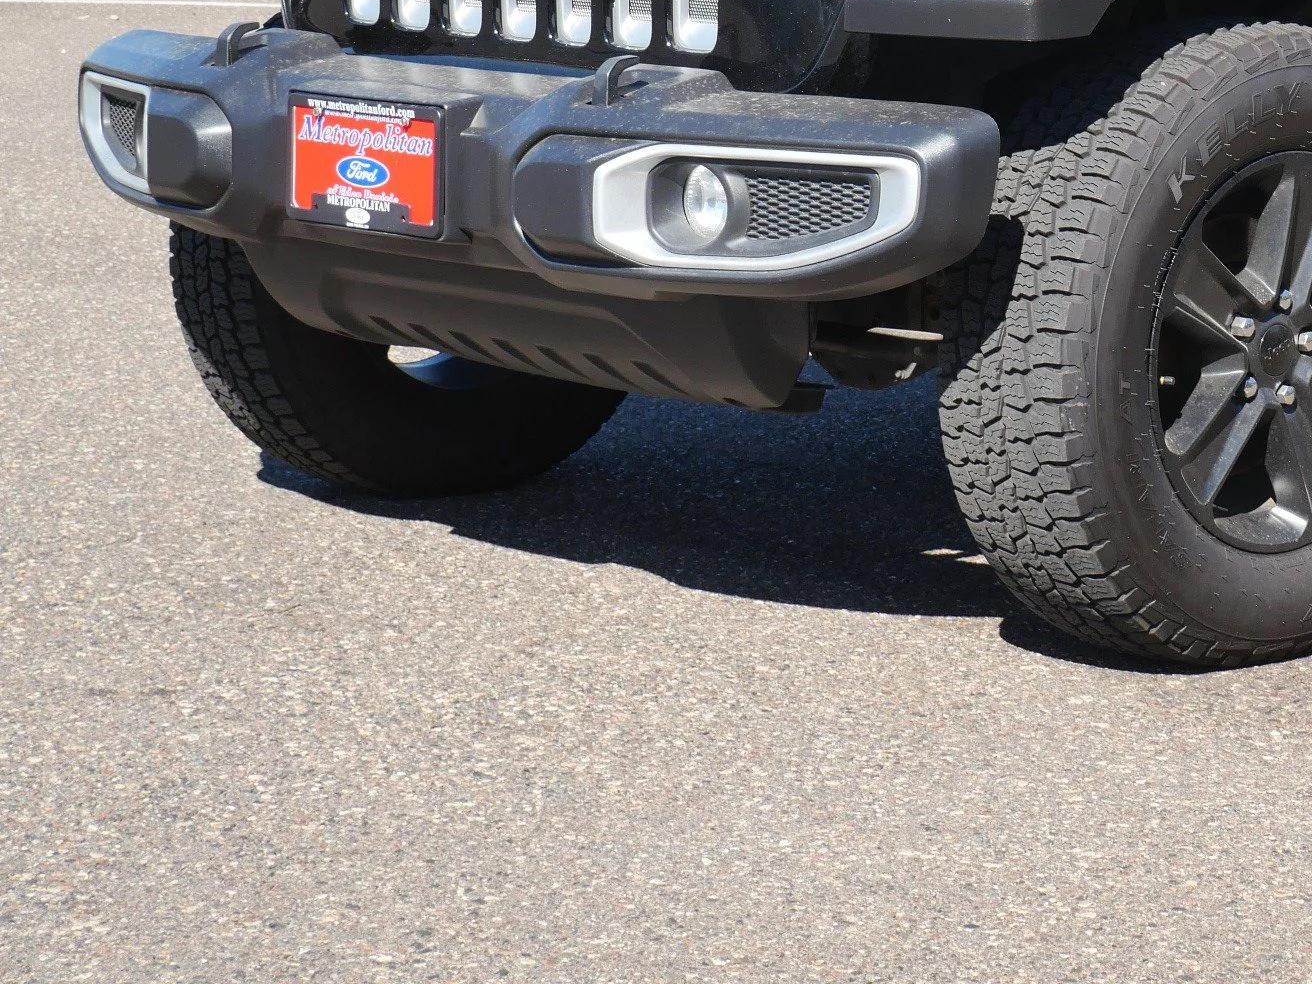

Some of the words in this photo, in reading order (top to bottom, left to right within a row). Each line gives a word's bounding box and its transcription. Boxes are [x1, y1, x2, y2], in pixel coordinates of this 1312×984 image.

[307, 98, 416, 119] www.metropolitanford.com
[298, 115, 433, 156] Metropolitan
[1165, 81, 1308, 204] KELLY
[346, 160, 378, 183] Ford
[326, 194, 391, 213] METROPOLITAN
